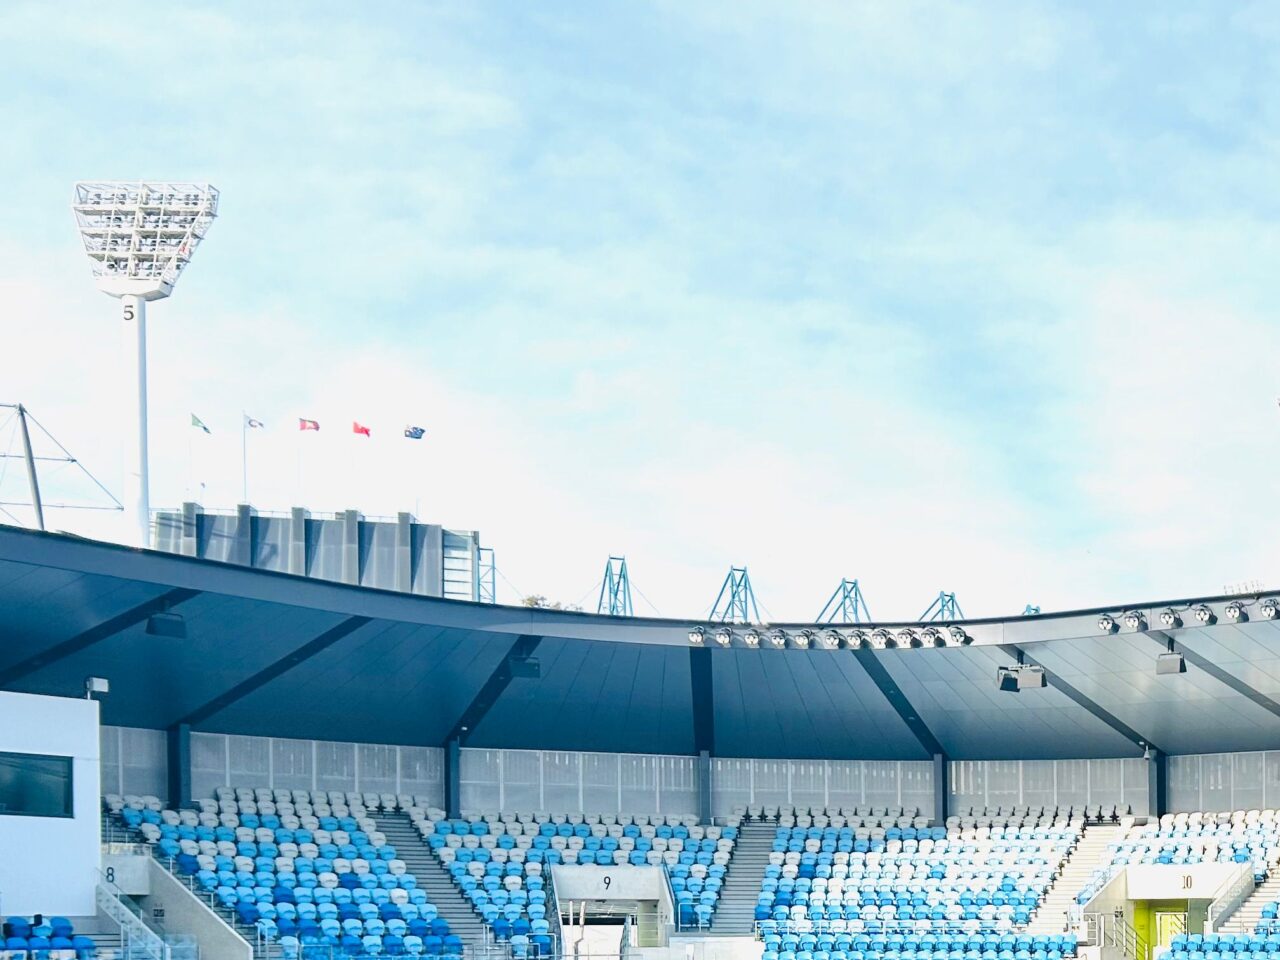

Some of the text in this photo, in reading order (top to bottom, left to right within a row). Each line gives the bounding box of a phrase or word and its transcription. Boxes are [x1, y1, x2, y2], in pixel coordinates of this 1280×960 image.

[123, 304, 135, 321] 5
[106, 866, 115, 883] 8
[603, 875, 611, 890] 9
[1181, 875, 1193, 890] 10
